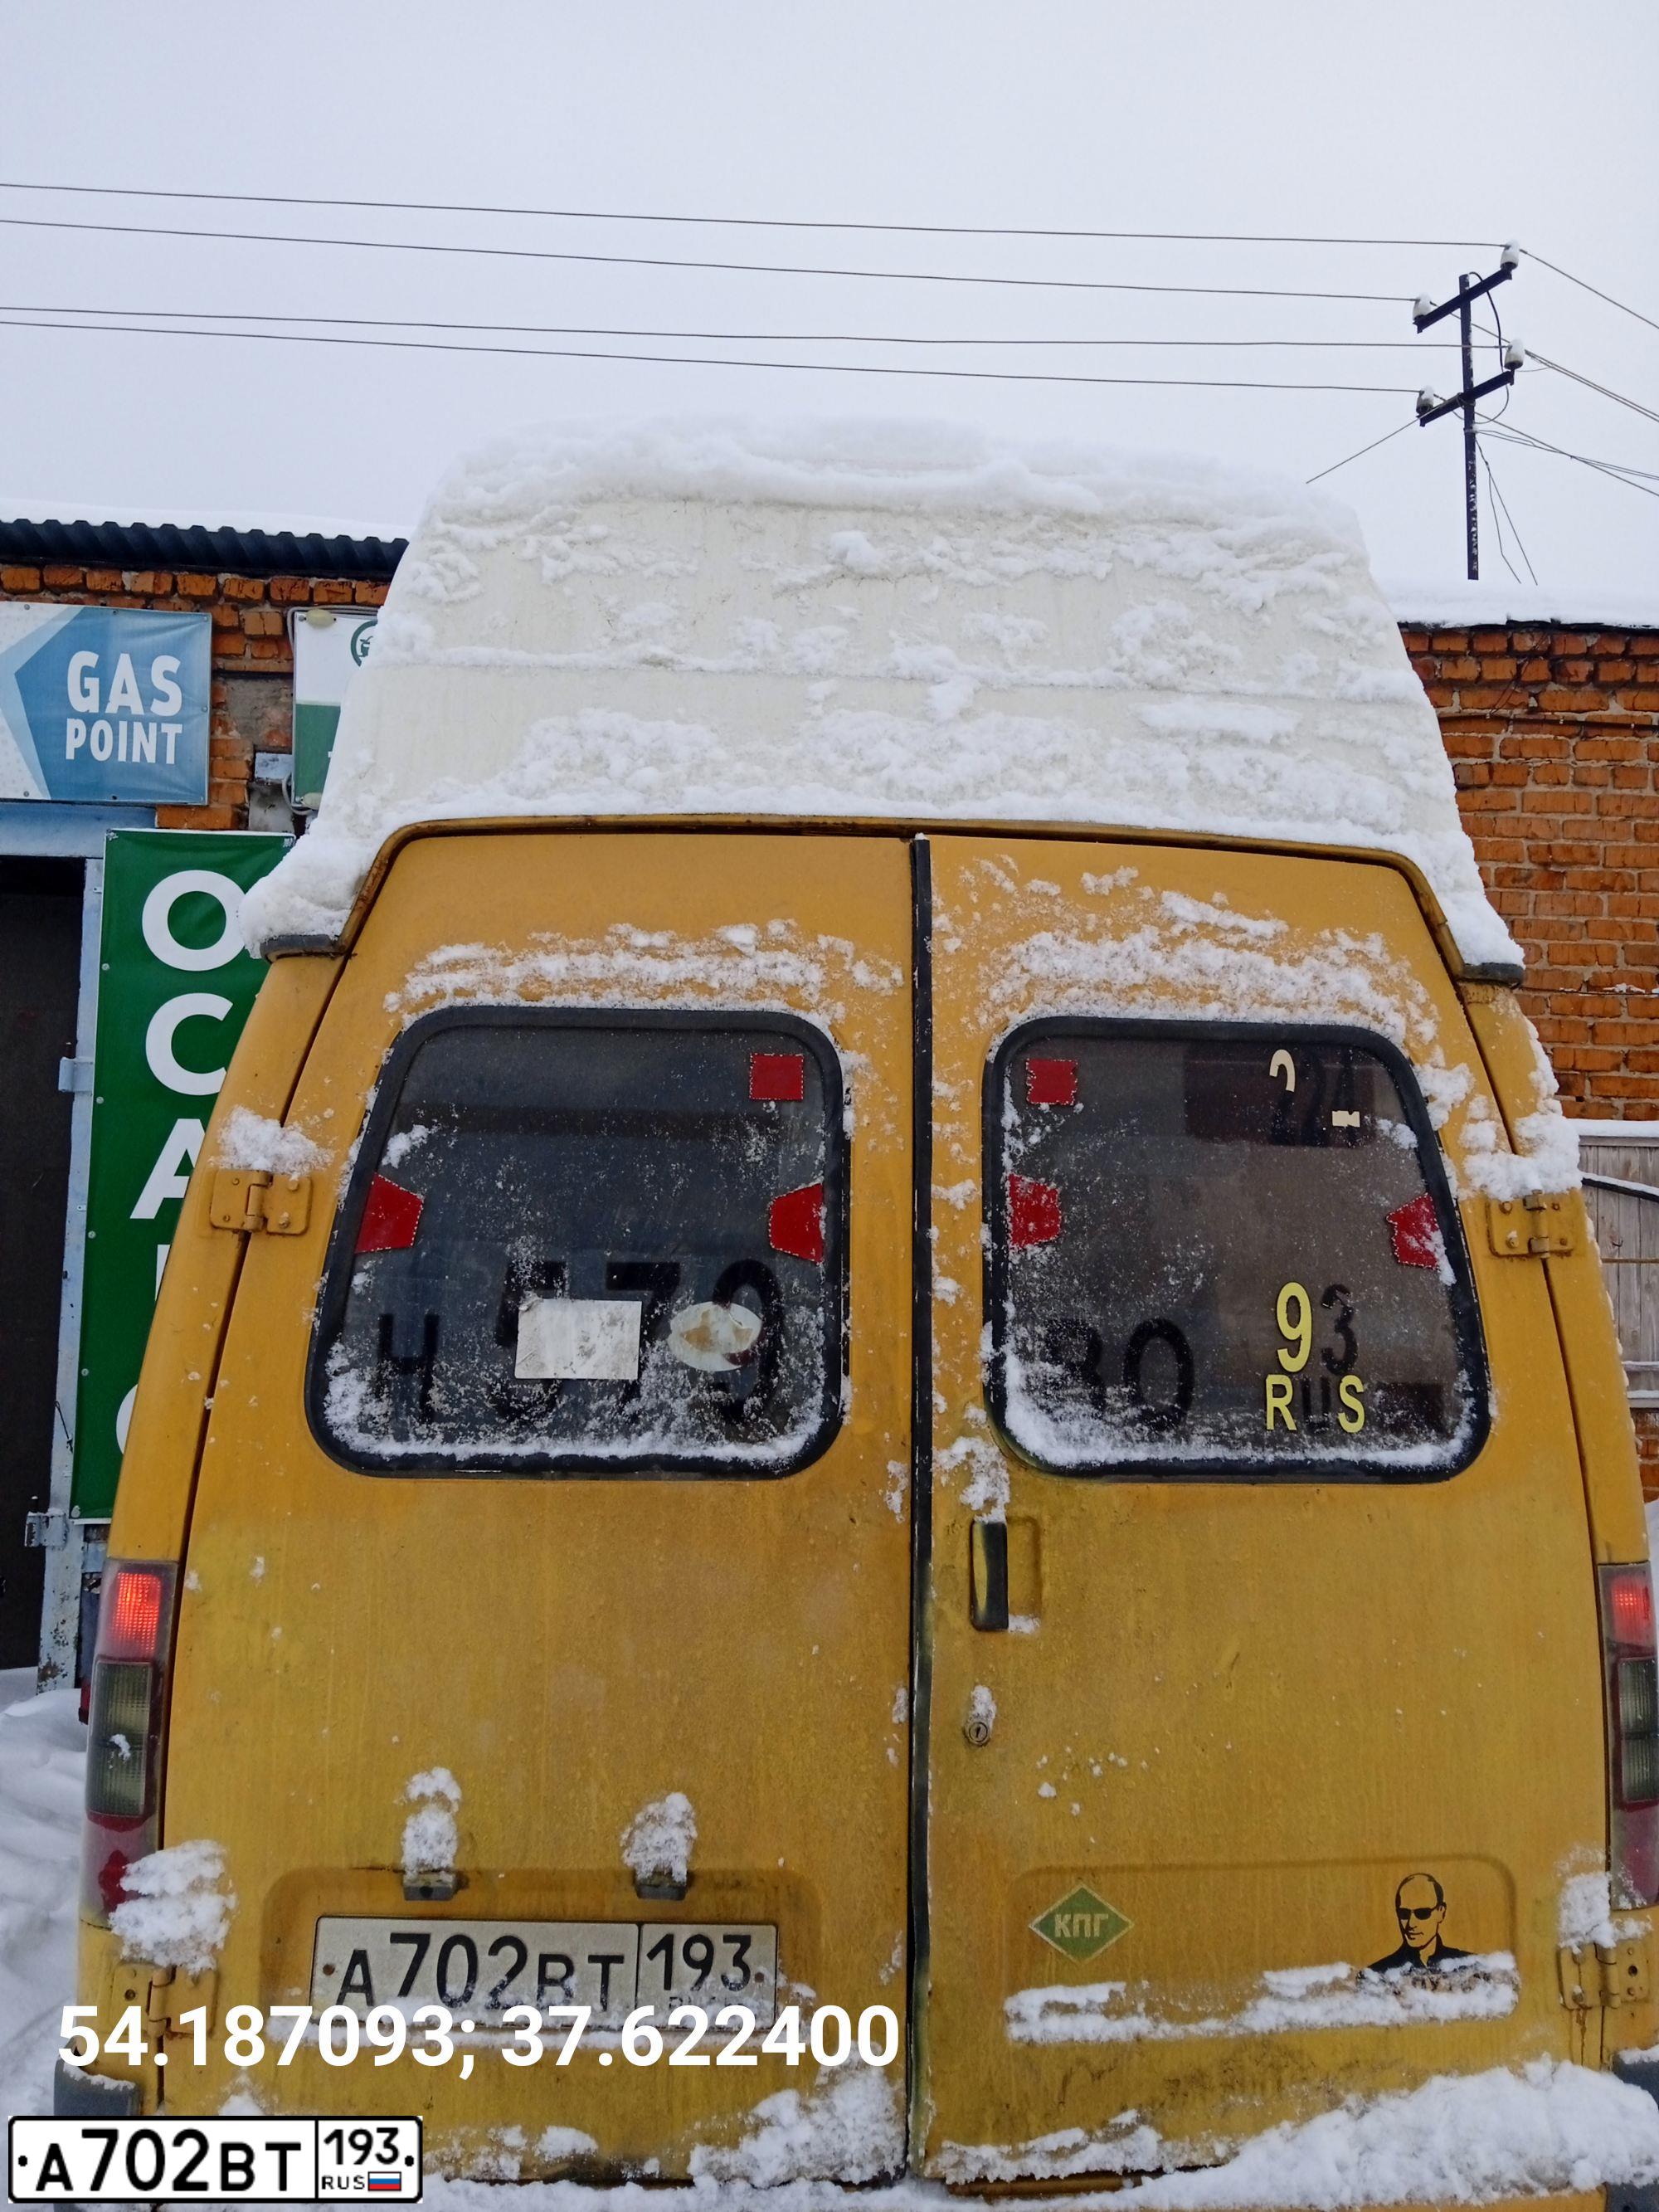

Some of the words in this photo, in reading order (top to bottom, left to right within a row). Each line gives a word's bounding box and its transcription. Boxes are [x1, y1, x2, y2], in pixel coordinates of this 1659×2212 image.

[66, 650, 182, 716] GAS
[66, 718, 182, 764] POINT
[115, 870, 247, 1457] ОСА
[1277, 1282, 1359, 1374] 93
[1265, 1373, 1365, 1434] RUS
[1053, 1912, 1109, 1938] КПГ
[336, 1932, 625, 2012] А702ВТ
[645, 1933, 752, 1992] 193
